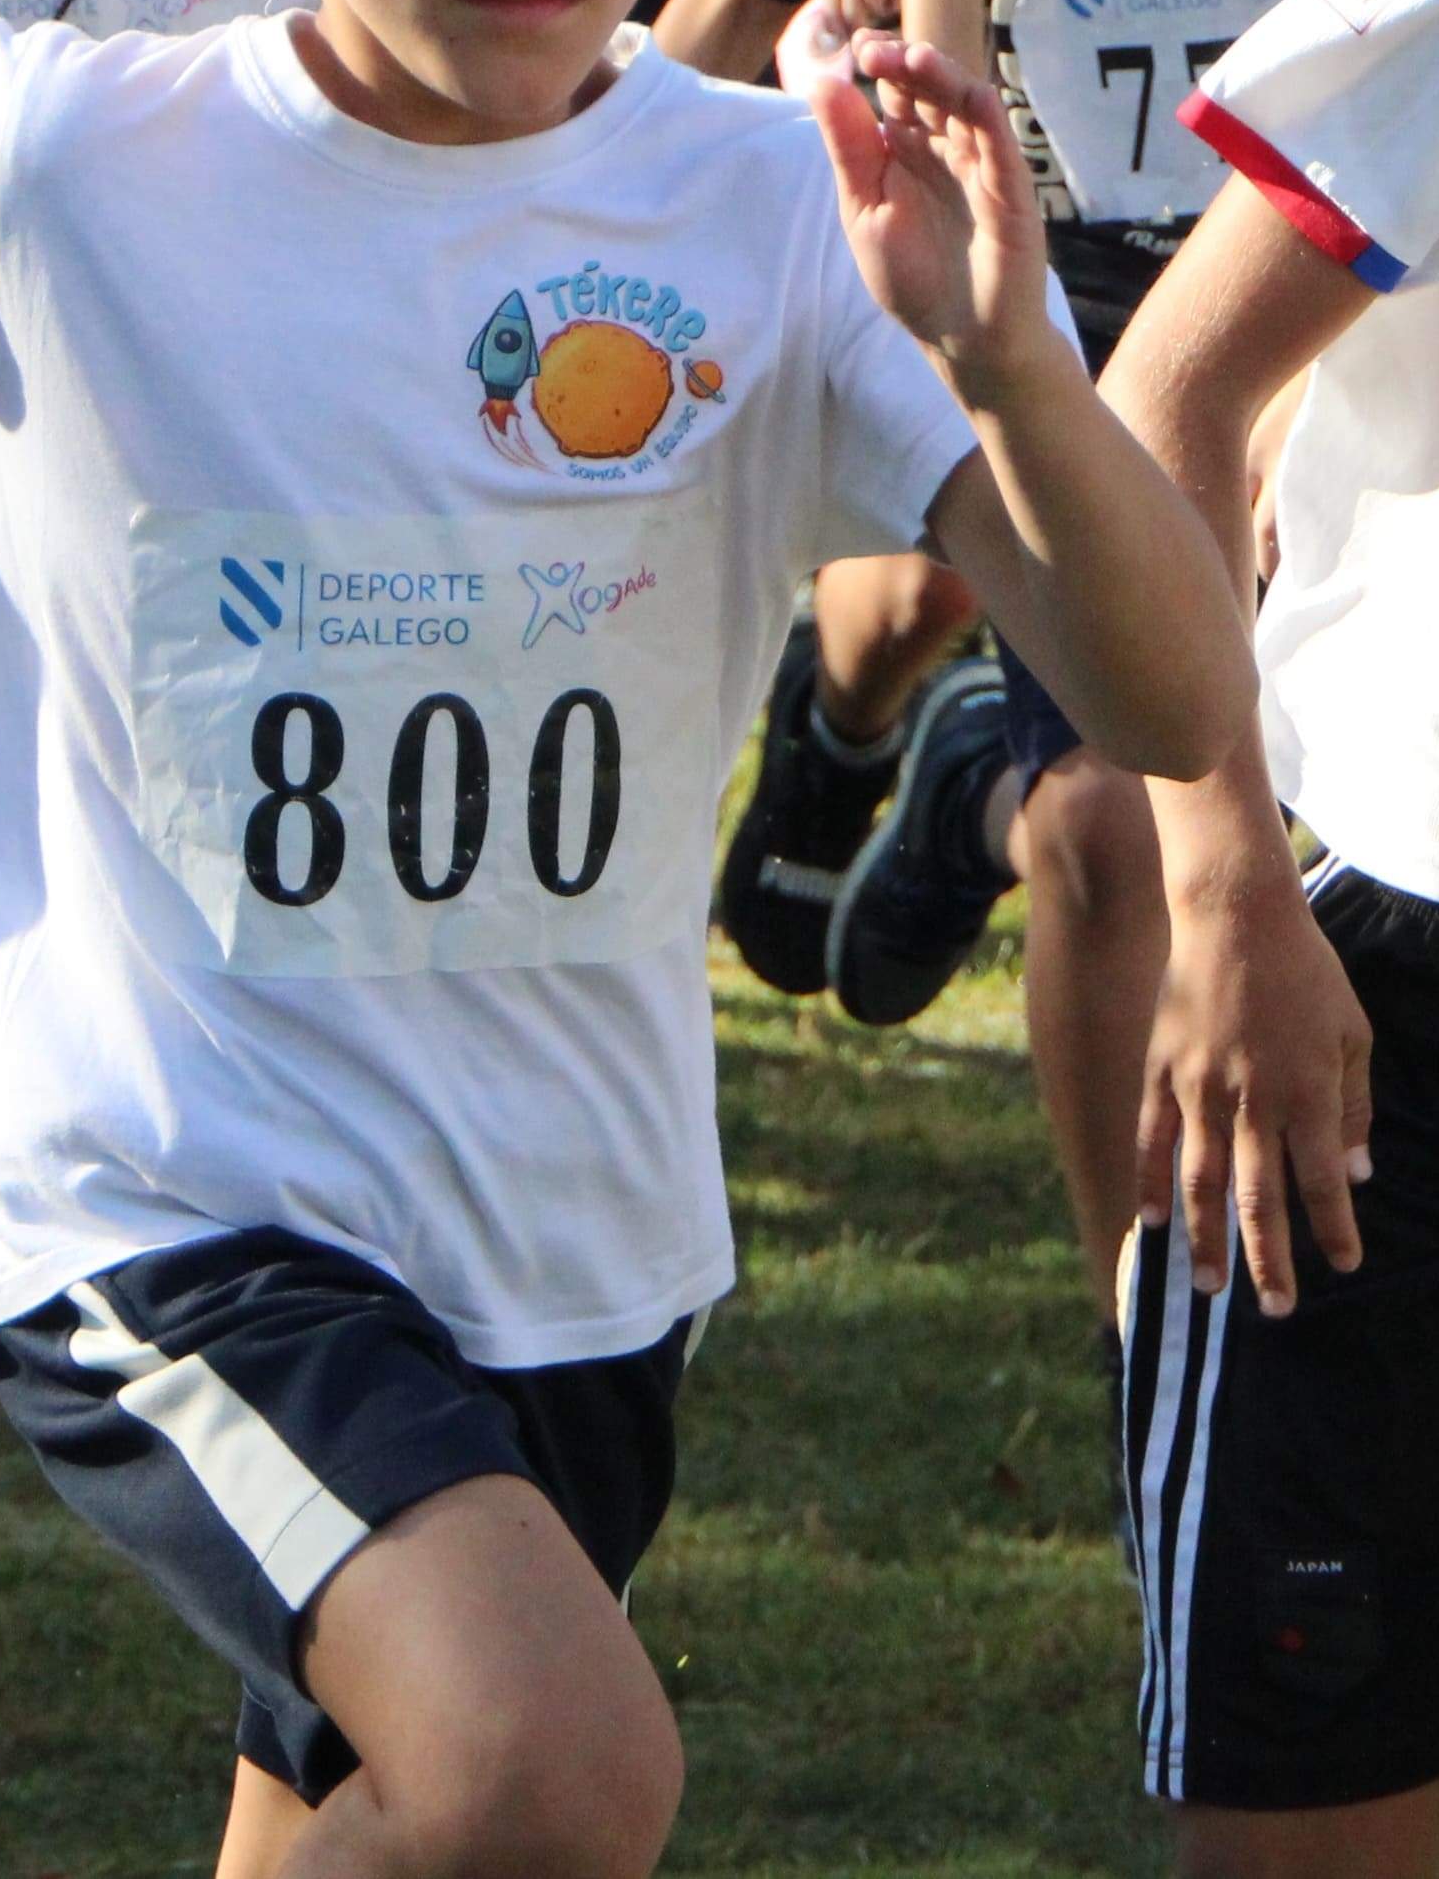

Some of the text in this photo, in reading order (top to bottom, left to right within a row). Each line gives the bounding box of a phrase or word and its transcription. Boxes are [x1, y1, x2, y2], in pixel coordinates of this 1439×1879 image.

[319, 571, 485, 604] DEPORTE
[319, 617, 469, 647] GALEGO
[243, 687, 622, 907] 800
[1285, 1560, 1343, 1573] JAPAN
